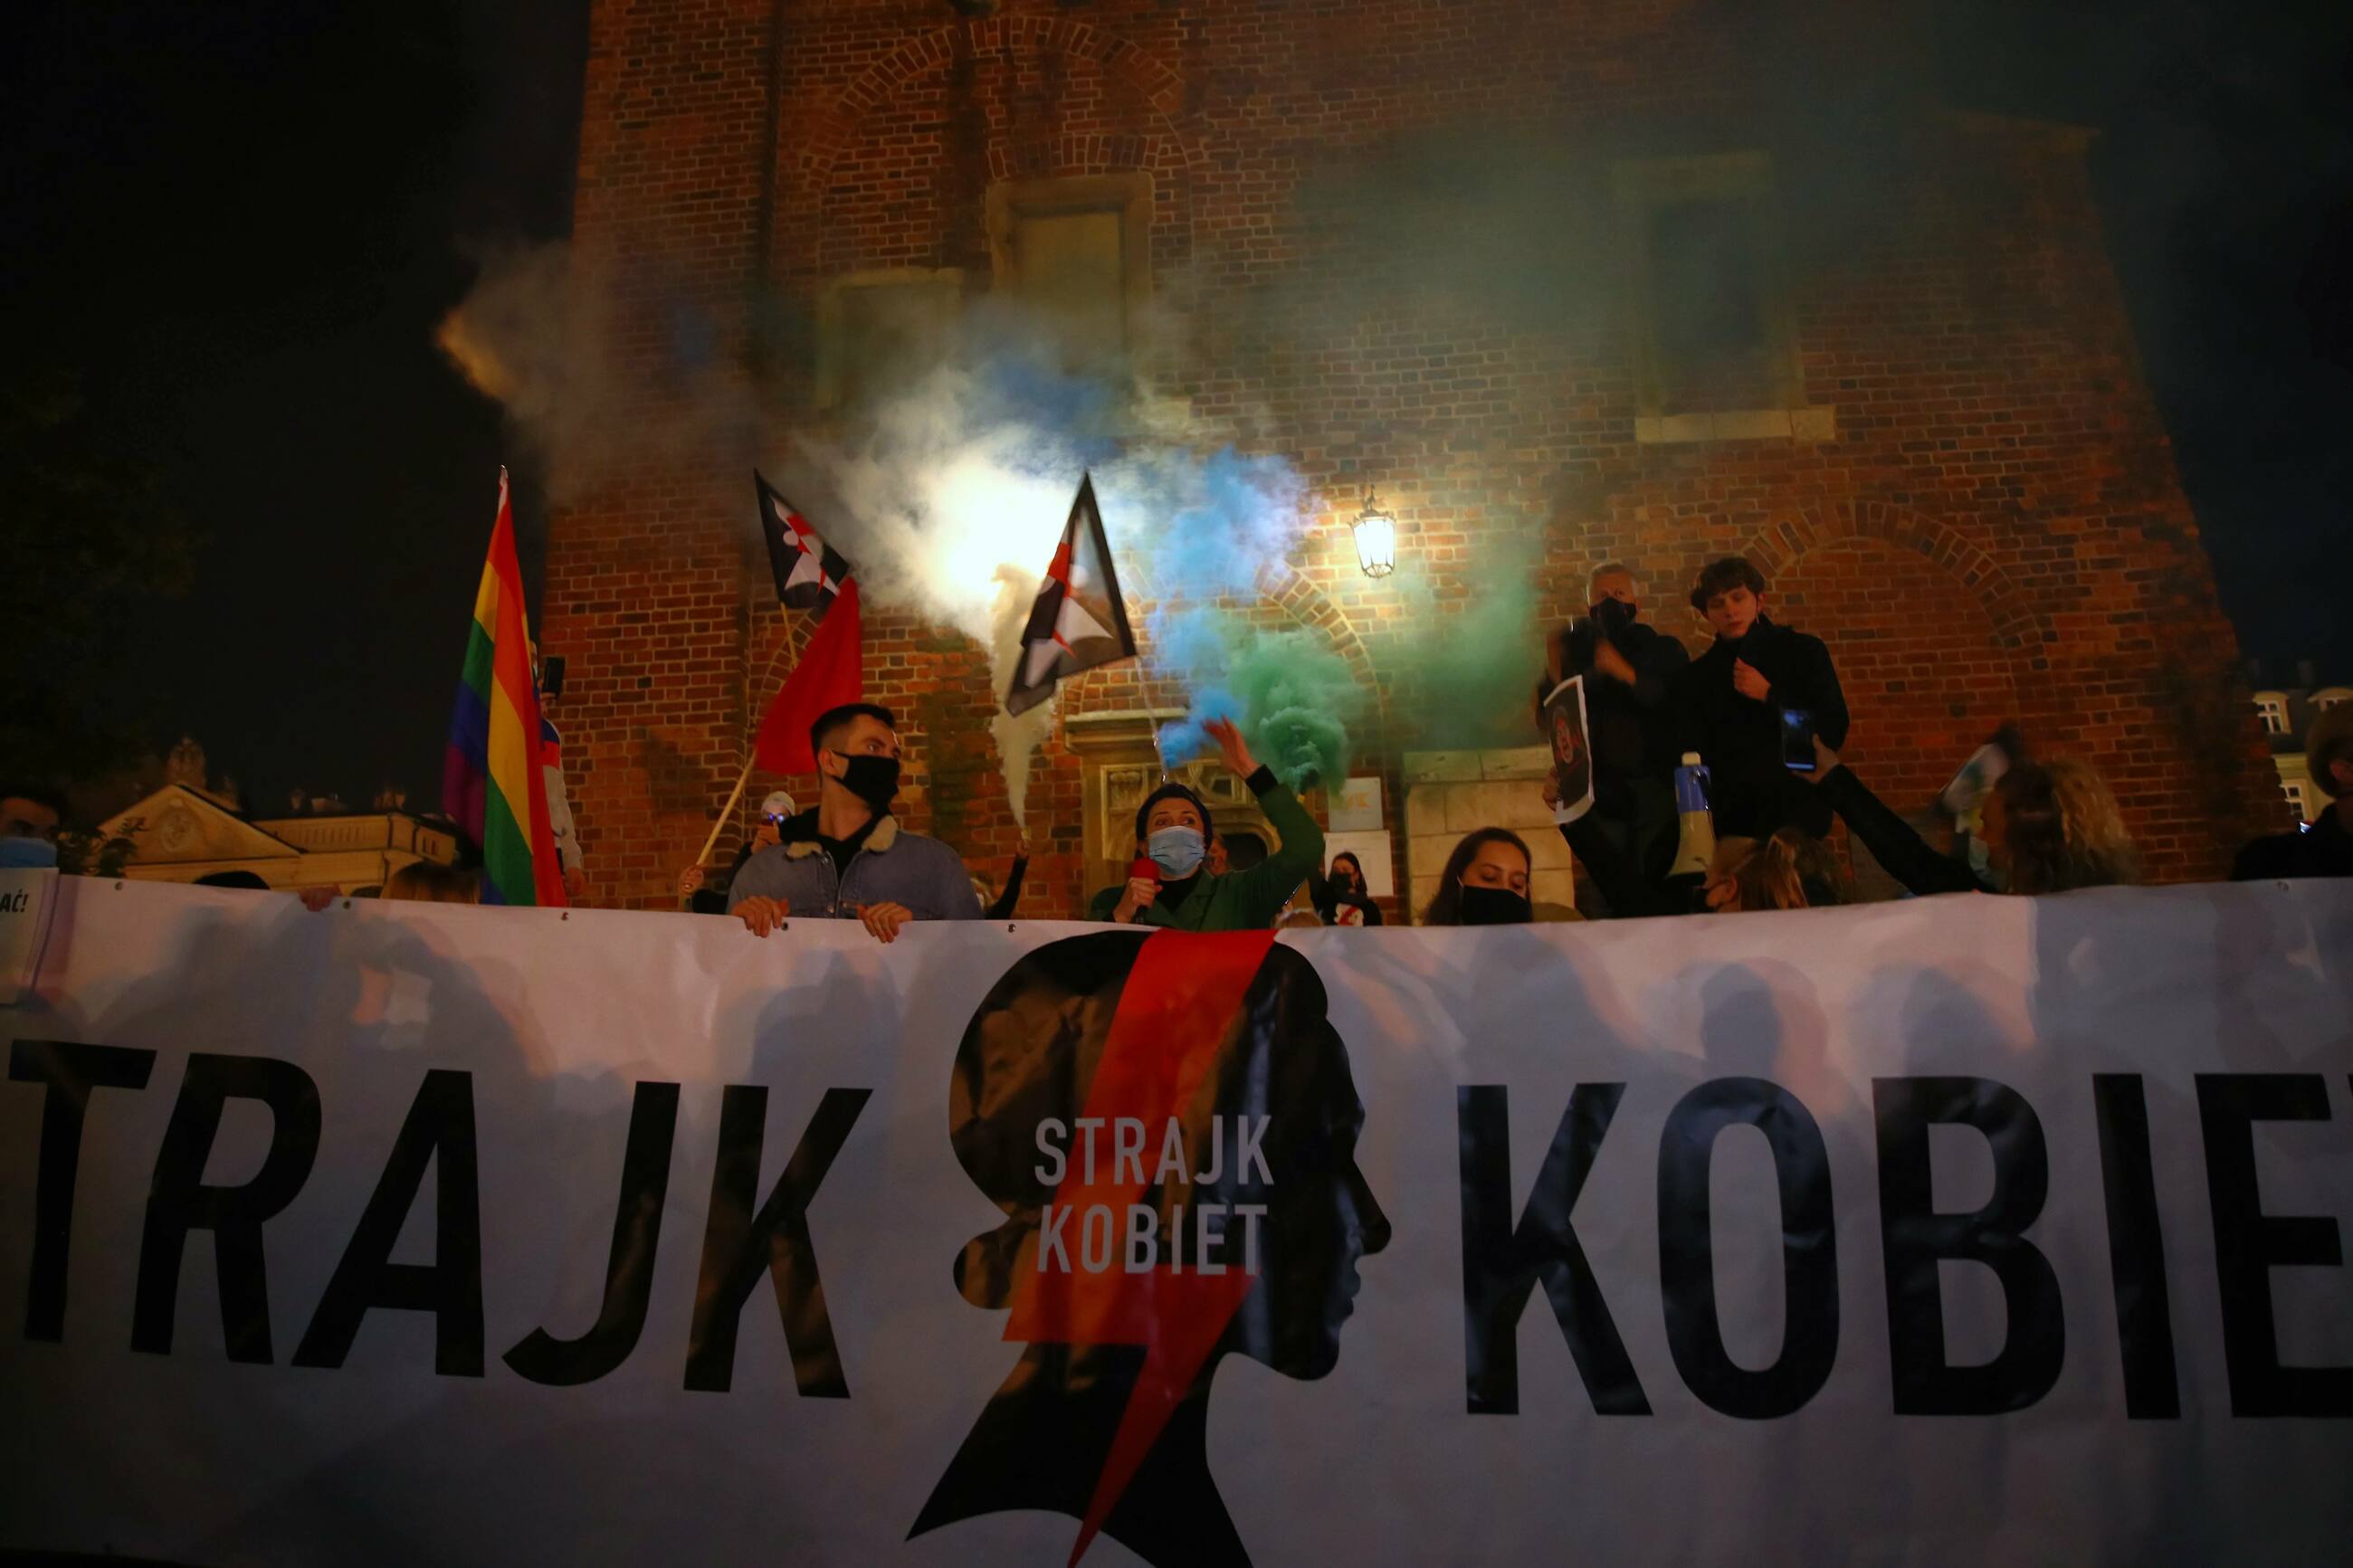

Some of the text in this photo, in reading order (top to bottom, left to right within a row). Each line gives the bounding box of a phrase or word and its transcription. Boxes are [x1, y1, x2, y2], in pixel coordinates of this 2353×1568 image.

[1034, 1115, 1274, 1186] STRAJK
[1037, 1203, 1268, 1276] KOBIET
[1456, 1073, 2353, 1419] KOBIE
